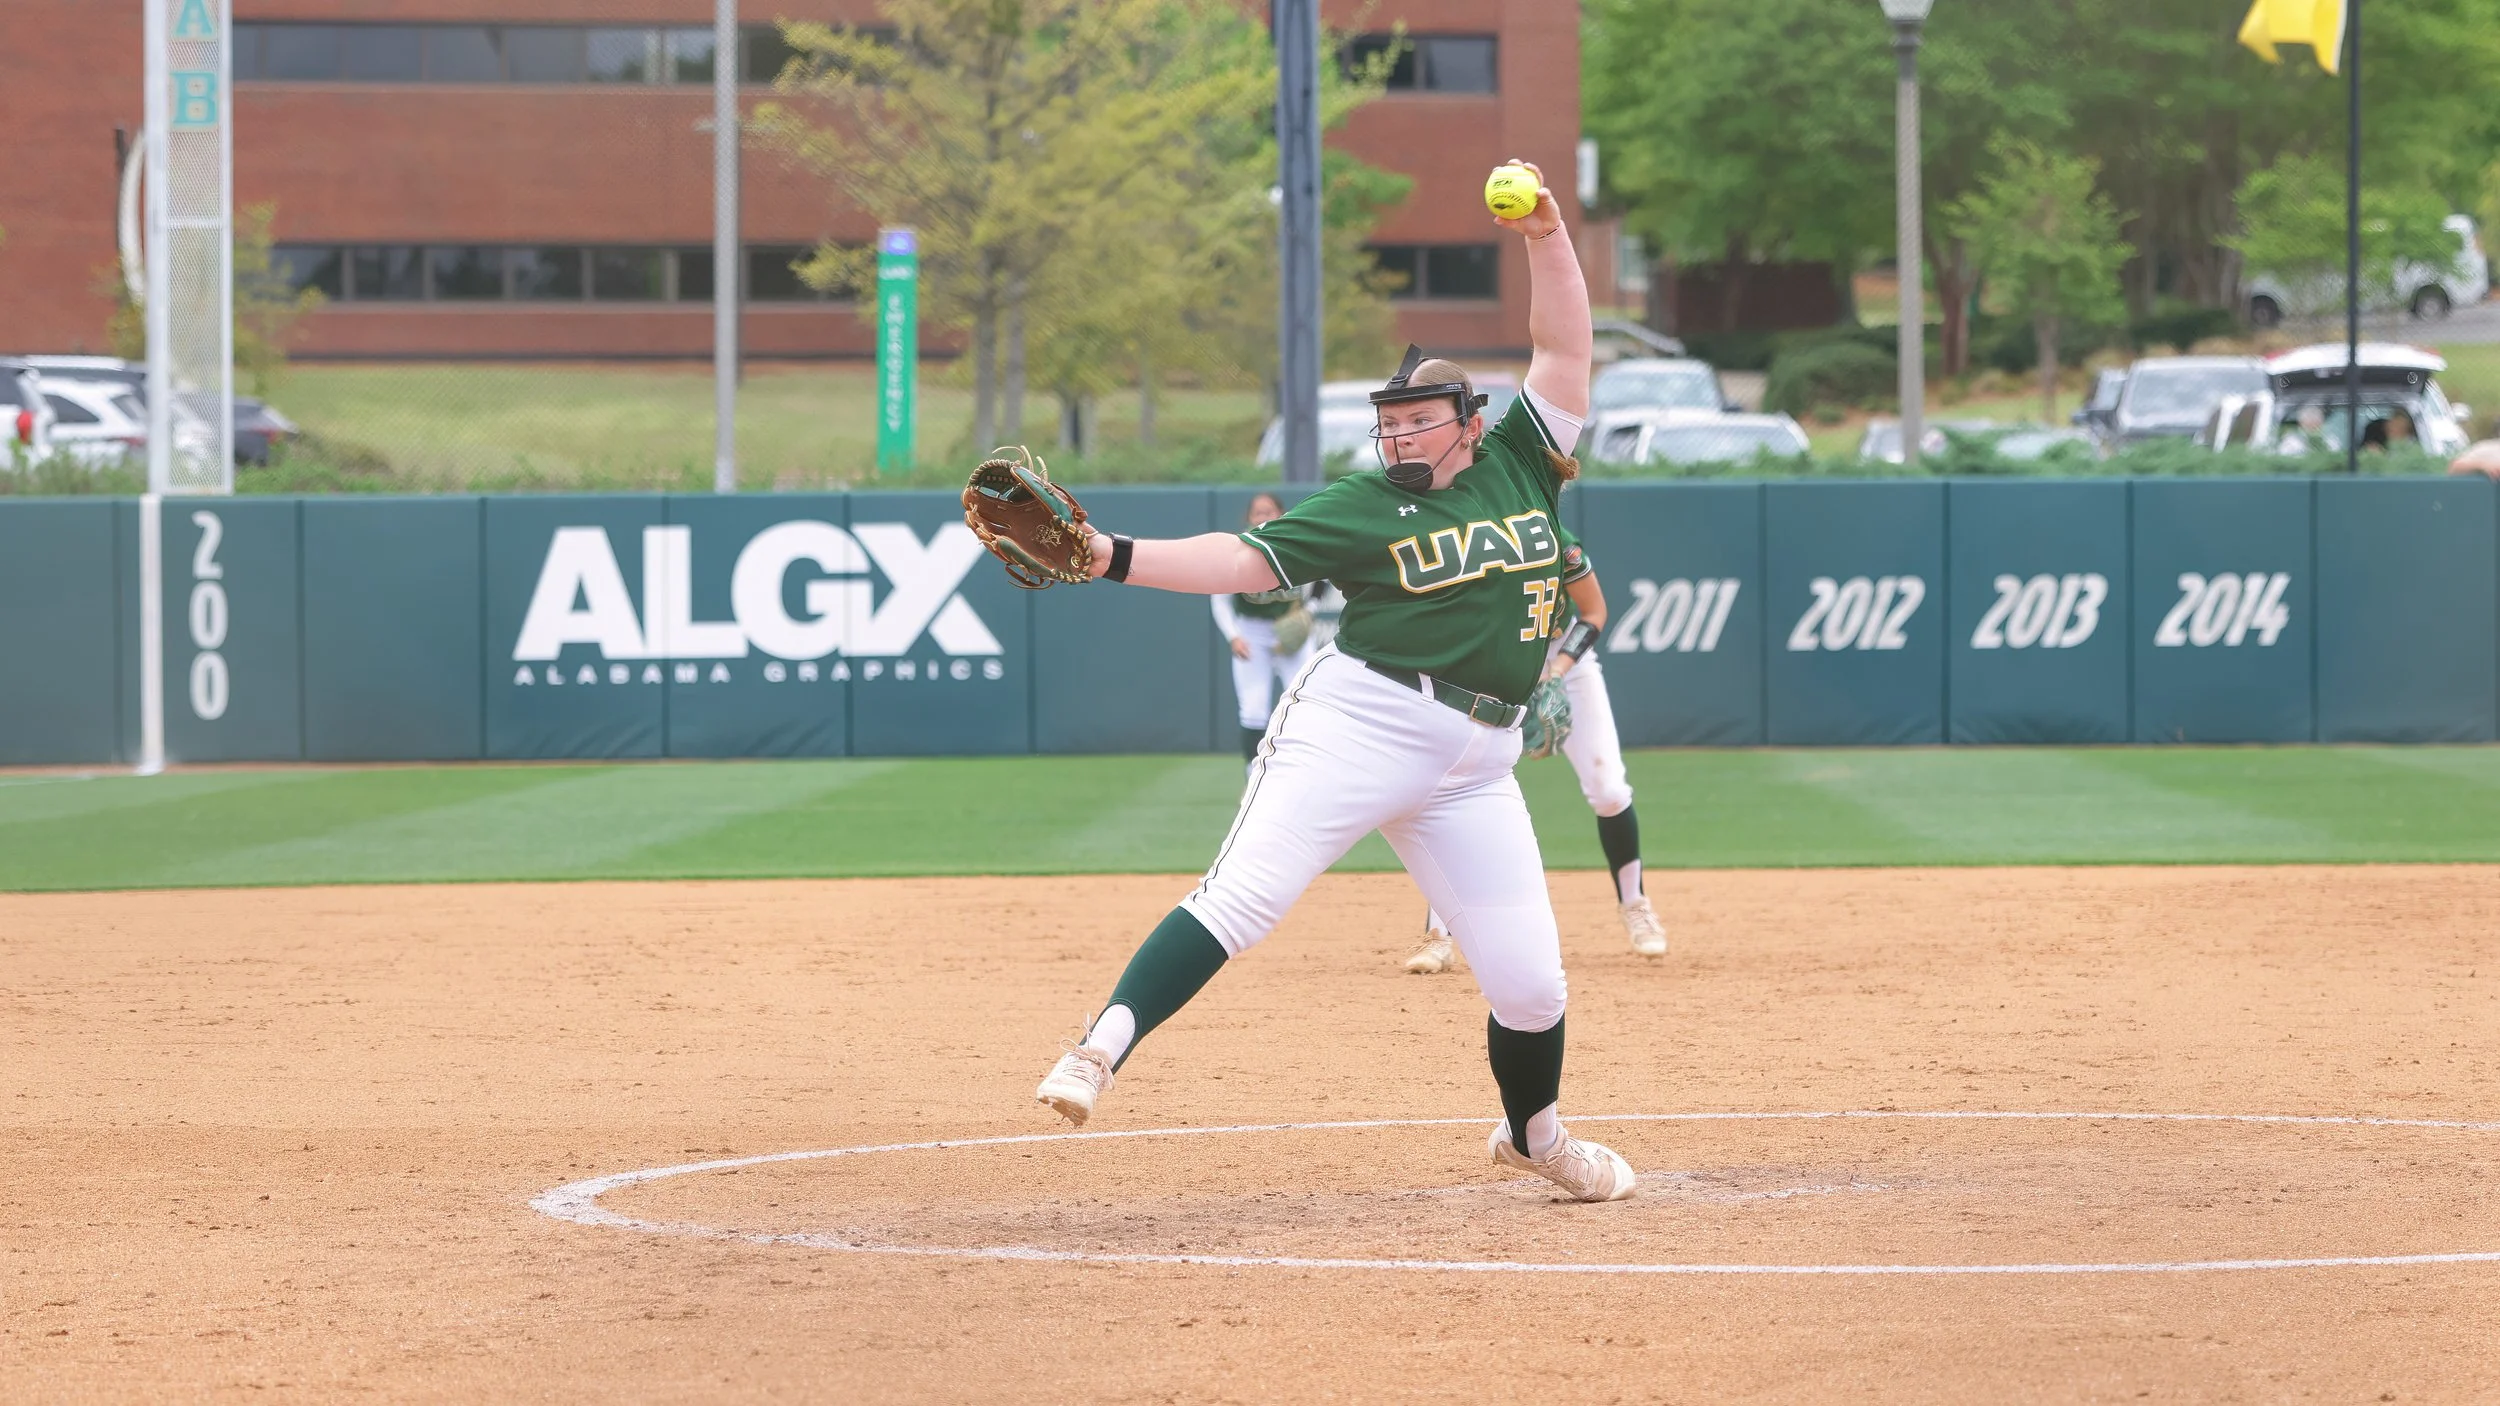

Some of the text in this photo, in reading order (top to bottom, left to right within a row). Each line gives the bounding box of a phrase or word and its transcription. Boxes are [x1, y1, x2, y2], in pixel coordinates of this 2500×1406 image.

[1388, 509, 1559, 594] UAB
[188, 510, 230, 721] 200
[512, 519, 1005, 661] ALGX
[1520, 576, 1560, 642] 32
[1607, 577, 1741, 653] 2011
[1787, 575, 1926, 651] 2012
[1970, 573, 2108, 649] 2013
[2154, 571, 2292, 647] 2014
[513, 658, 1004, 686] ALABAMA GRAPHICS
